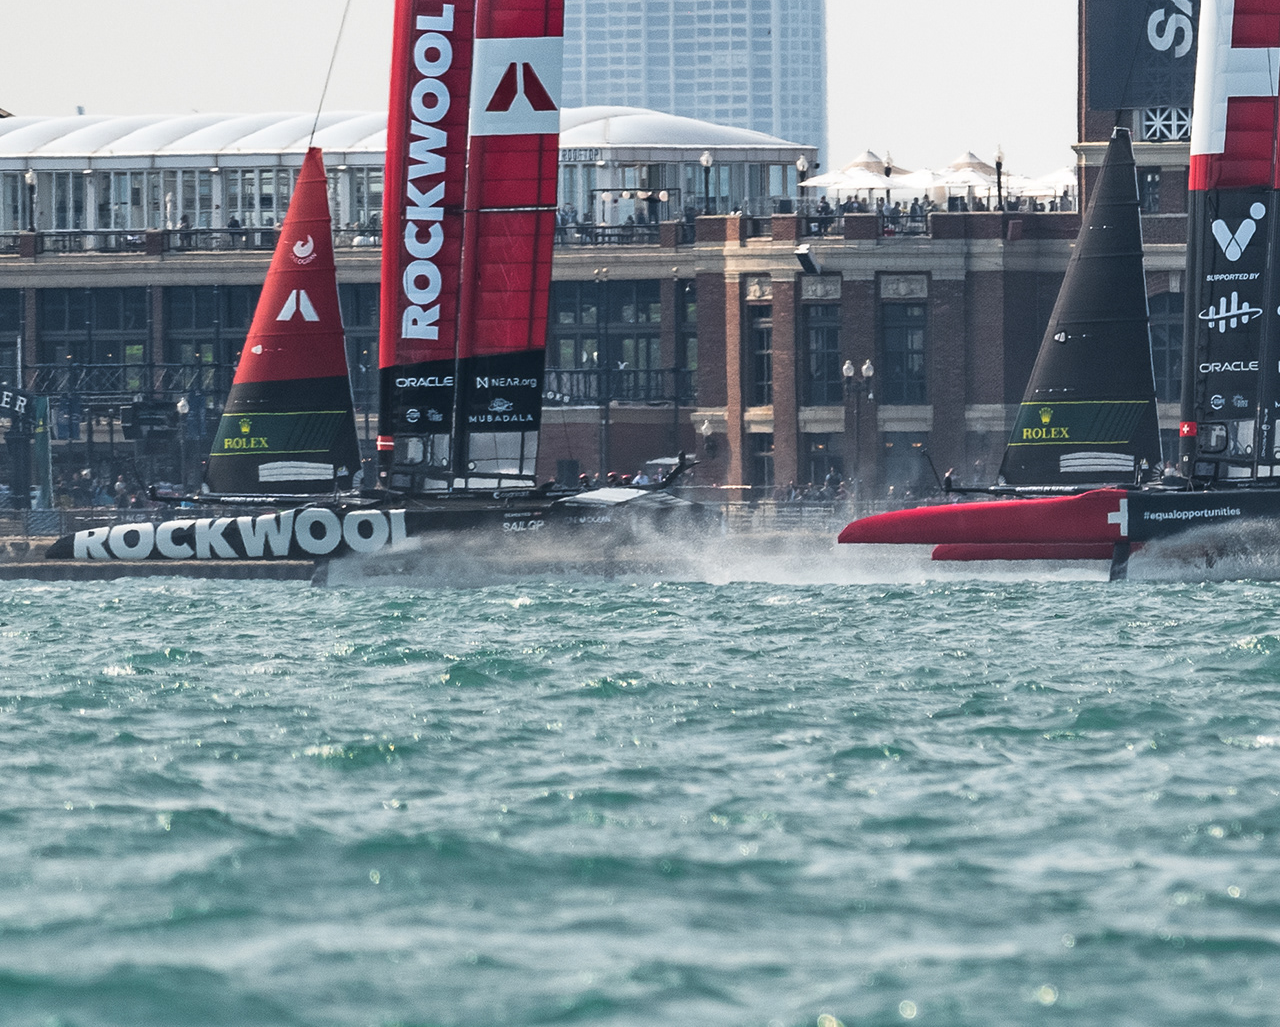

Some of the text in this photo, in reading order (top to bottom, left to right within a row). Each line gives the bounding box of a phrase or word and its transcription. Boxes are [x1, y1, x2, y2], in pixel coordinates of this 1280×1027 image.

[401, 4, 455, 340] ROCKWOOL
[1206, 273, 1248, 282] SUPPORTED
[1199, 360, 1259, 373] ORACLE
[395, 376, 454, 388] ORACLE
[490, 377, 537, 388] NEAR.org
[468, 414, 534, 423] MUBADALA
[1023, 427, 1070, 440] ROLEX
[224, 437, 269, 450] ROLEX
[1144, 506, 1241, 522] #equalopportunities
[503, 521, 526, 532] SAIL
[73, 507, 411, 560] ROCKWOOL
